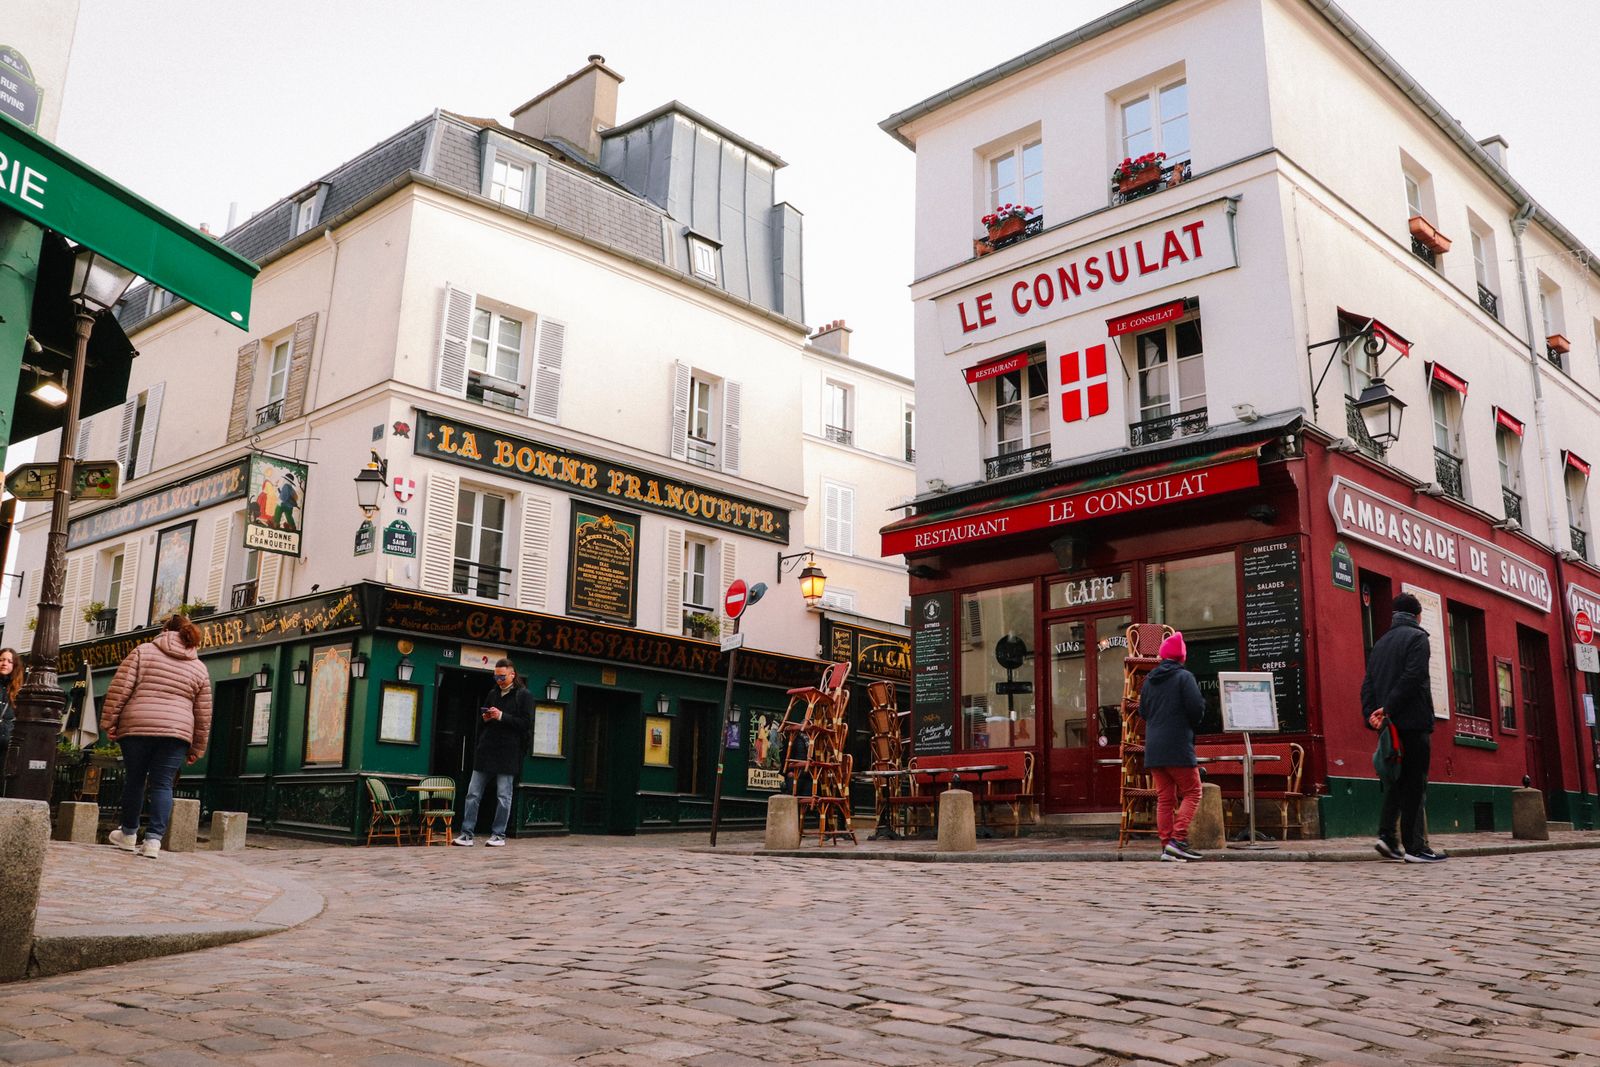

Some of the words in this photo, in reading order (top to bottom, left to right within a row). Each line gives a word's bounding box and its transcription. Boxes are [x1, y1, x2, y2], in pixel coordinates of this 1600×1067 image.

[0, 76, 18, 94] RUE
[958, 292, 997, 334] LE
[1011, 220, 1205, 315] CONSULAT
[1117, 323, 1128, 331] LE
[1129, 308, 1174, 328] CONSULAT
[975, 358, 1019, 379] RESTAURANT
[437, 425, 482, 461] LA
[493, 439, 598, 489] BONNE
[607, 469, 774, 533] FRANQUETTE
[72, 523, 89, 542] LA
[94, 504, 137, 537] BONNE
[140, 467, 242, 521] FRANQUETTE
[914, 517, 1009, 548] RESTAURANT
[1049, 499, 1076, 523] LE
[1085, 472, 1209, 515] CONSULAT
[250, 535, 296, 551] FRANQUETTE
[255, 527, 265, 537] LA
[268, 531, 292, 543] BONNE
[392, 538, 408, 547] SAINT
[394, 532, 406, 540] RUE
[386, 544, 412, 554] RUSTIQUE
[1253, 542, 1288, 554] OMELETTES
[1342, 493, 1456, 565] AMBASSADE
[1469, 545, 1489, 577] DE
[1500, 558, 1547, 601] SAVOIE
[1064, 576, 1115, 605] CAFE
[1256, 580, 1285, 591] SALADES
[56, 649, 76, 673] AFÉ
[197, 619, 244, 651] ARET
[466, 611, 542, 647] CAFÉ
[554, 624, 722, 673] RESTAURANT
[1055, 641, 1080, 653] VINS
[1097, 636, 1129, 653] LQUEUR
[873, 650, 883, 663] LA
[1262, 660, 1287, 670] CRÊPES
[750, 777, 782, 787] FRANQUETT
